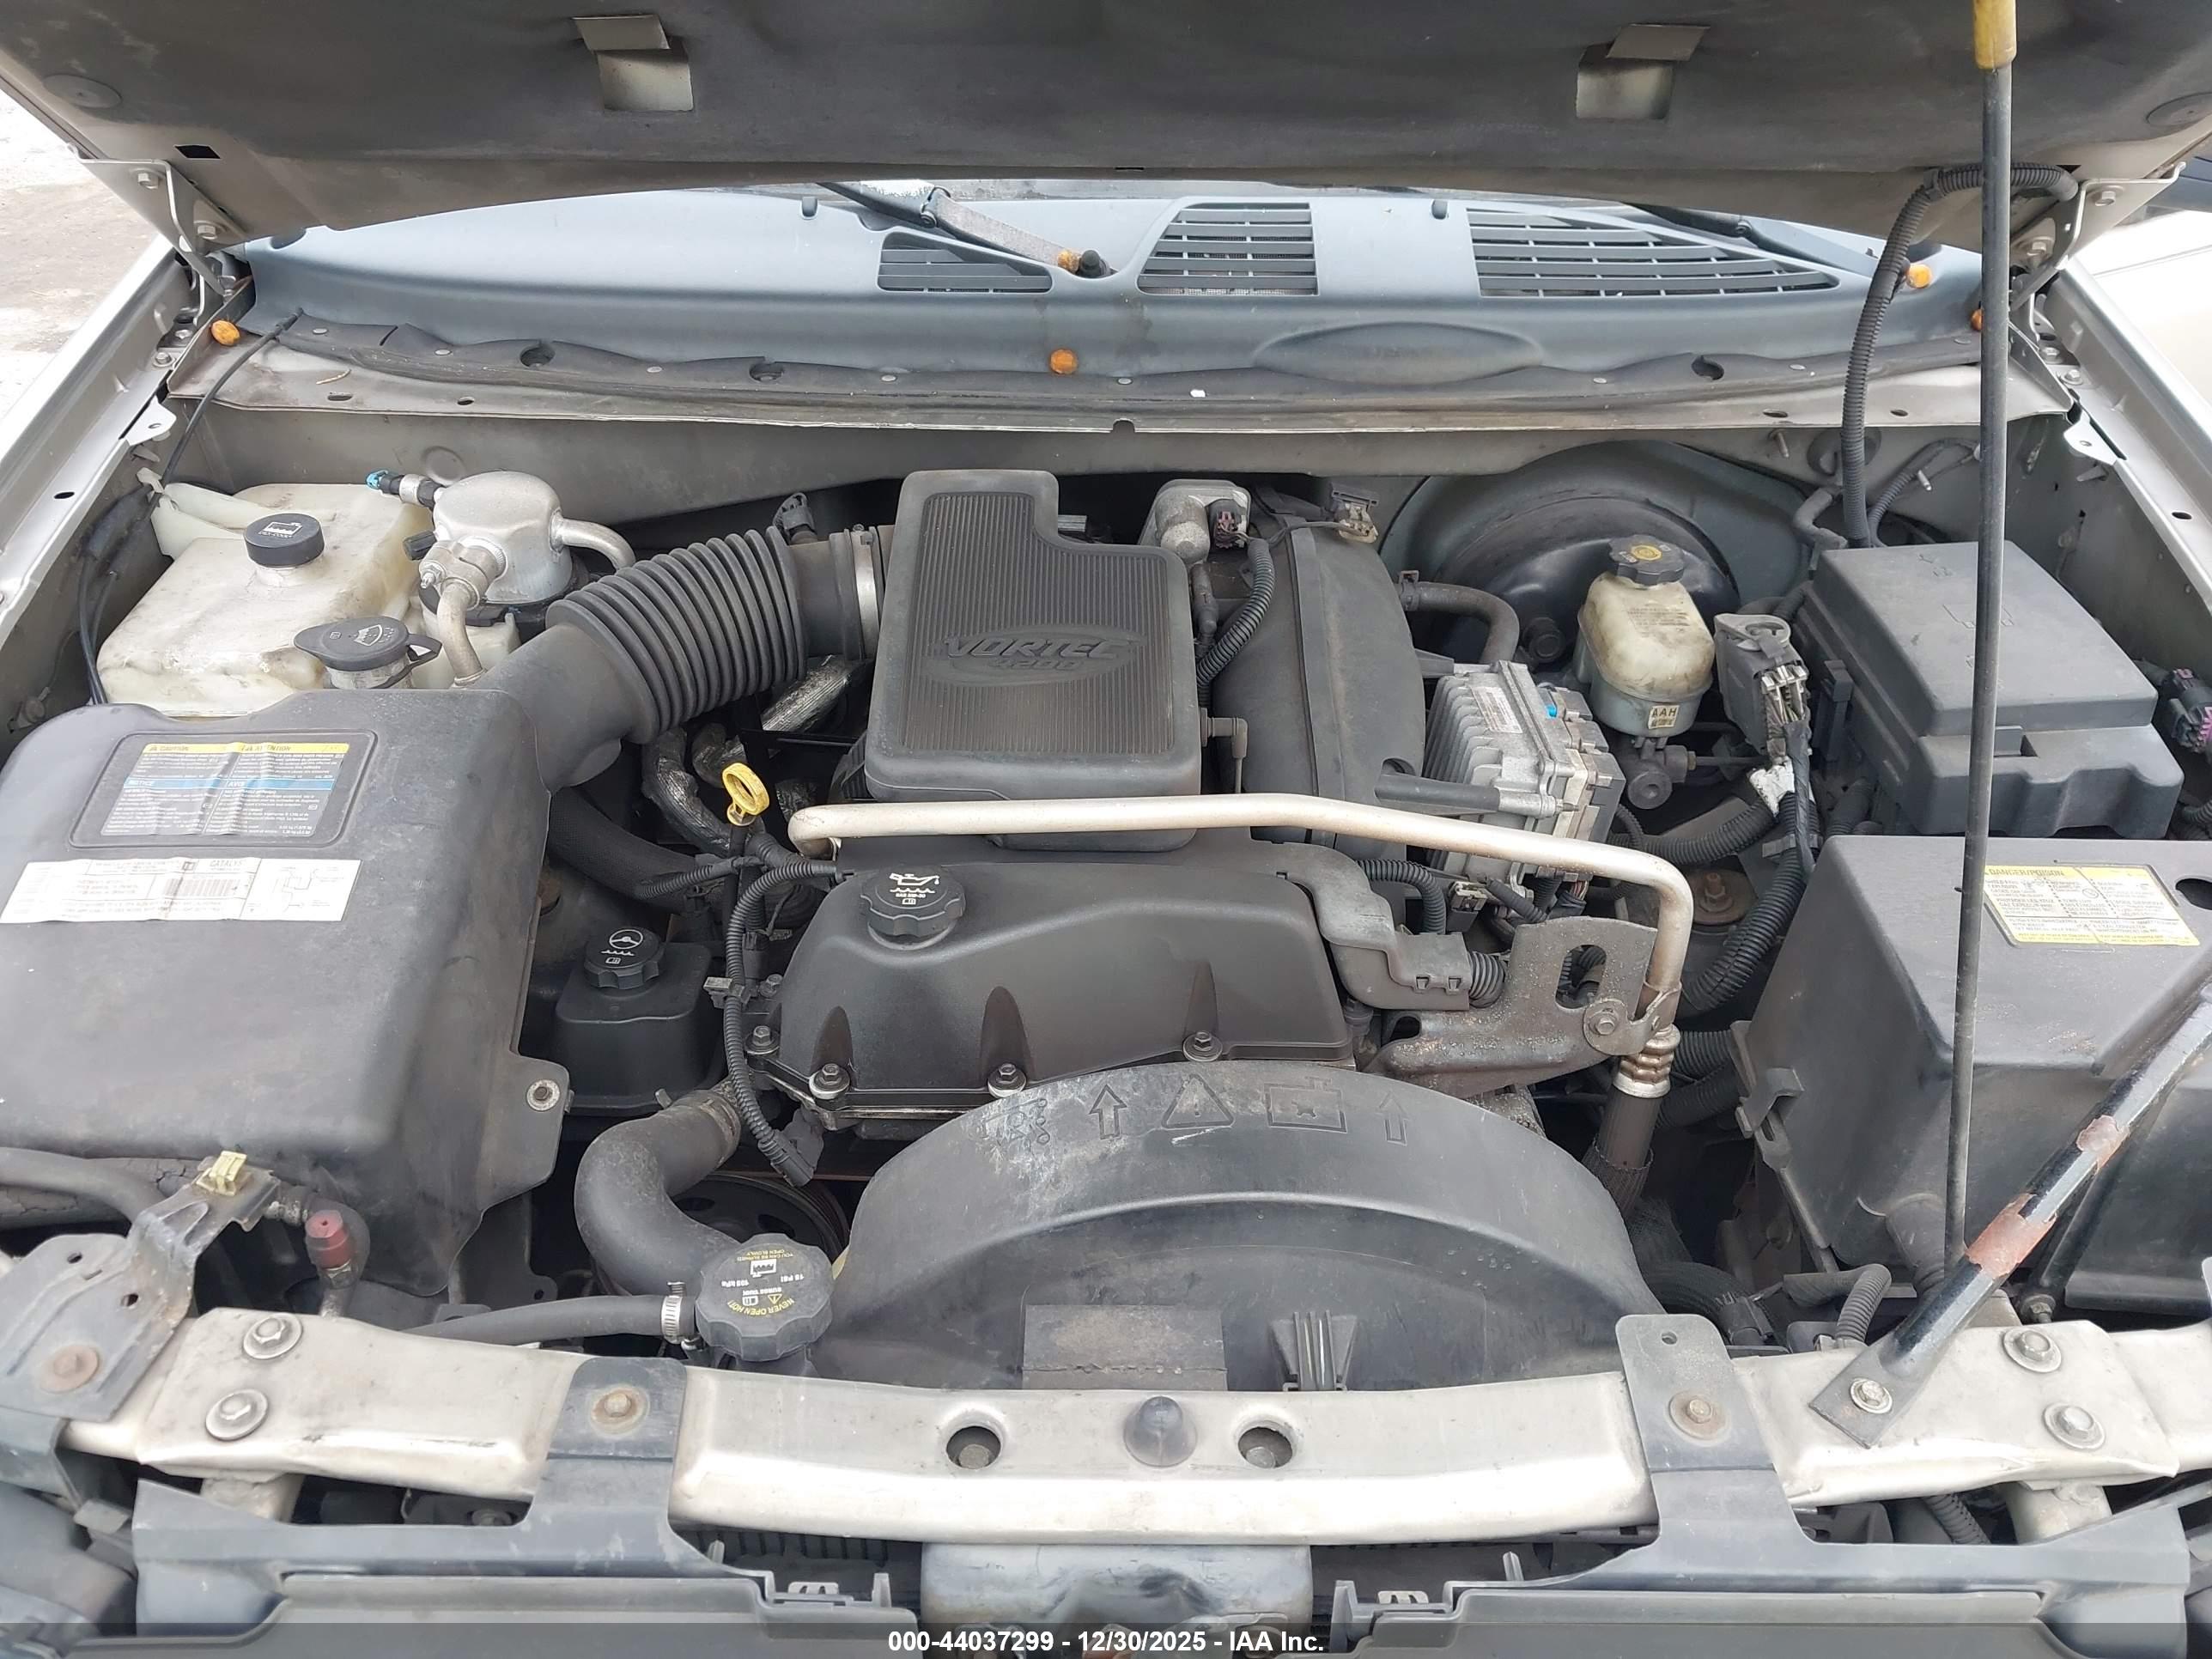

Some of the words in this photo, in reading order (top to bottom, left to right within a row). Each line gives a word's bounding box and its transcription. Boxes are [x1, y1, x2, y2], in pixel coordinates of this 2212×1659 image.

[945, 637, 1129, 659] VORTEC
[1652, 708, 1677, 717] AAH
[744, 1307, 767, 1316] OPEN
[768, 1297, 795, 1314] NEVER
